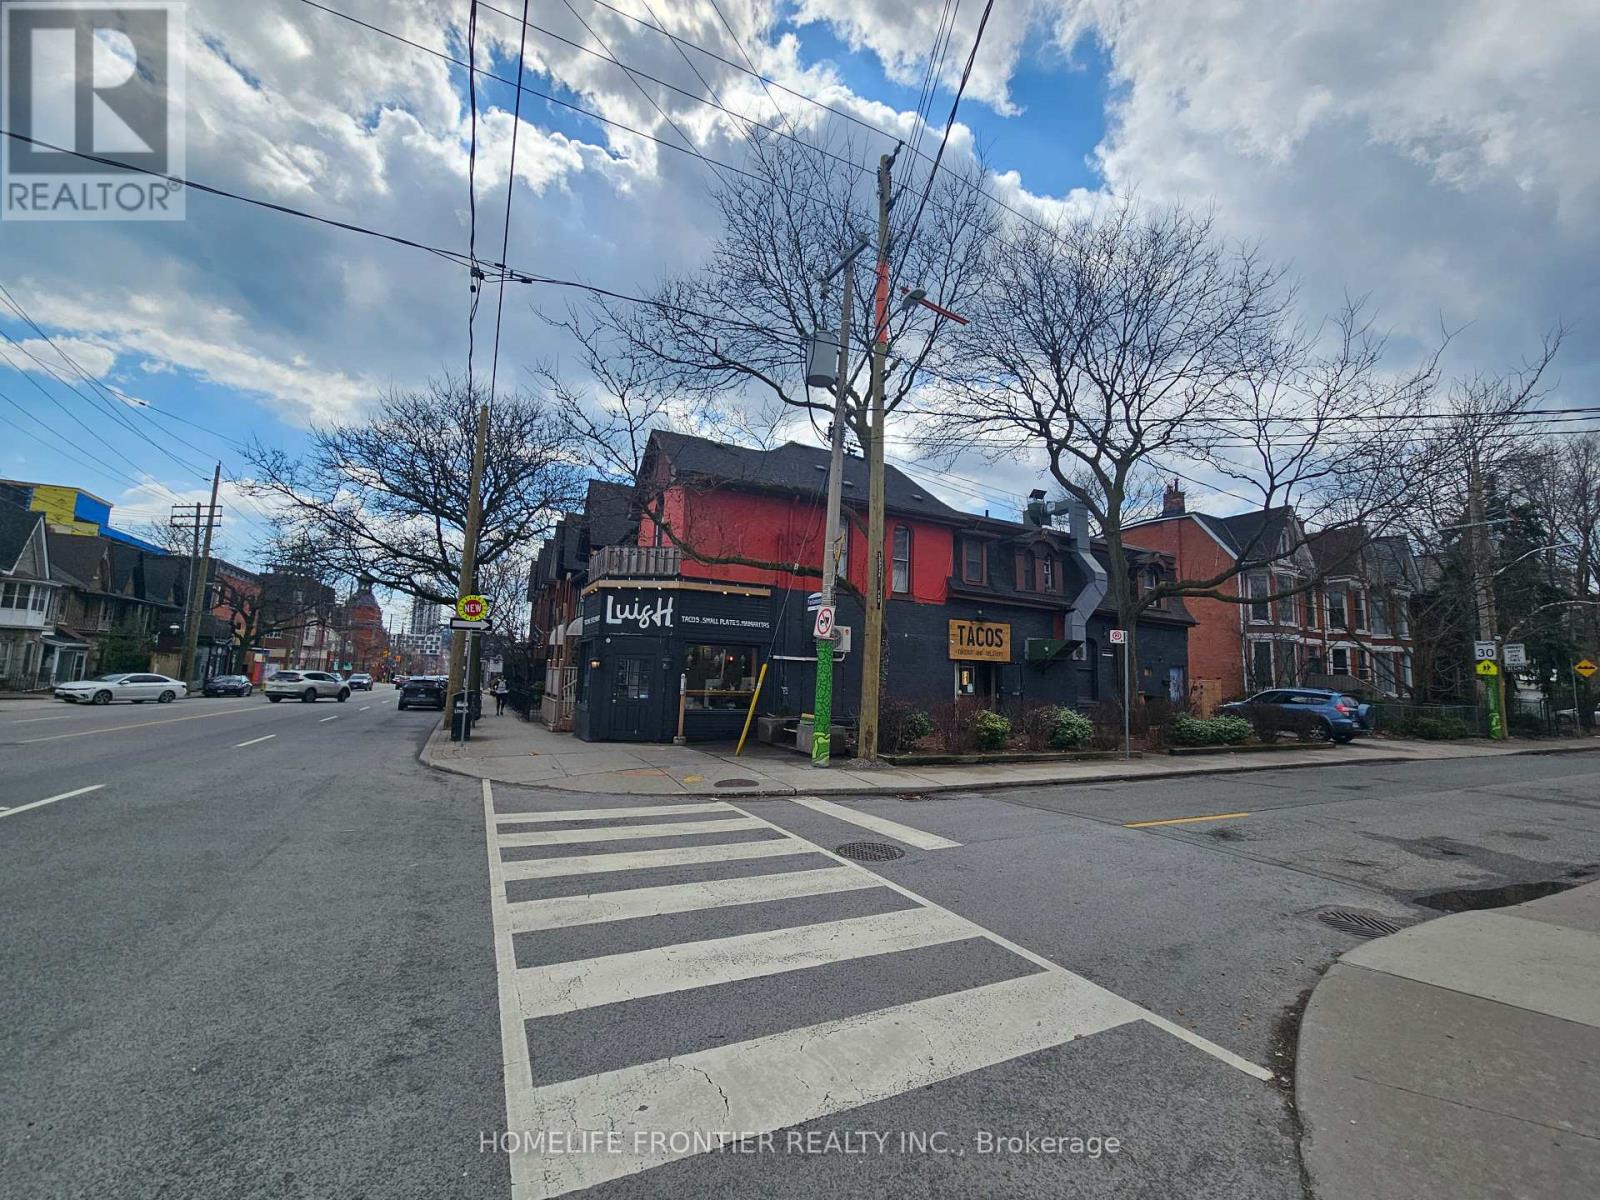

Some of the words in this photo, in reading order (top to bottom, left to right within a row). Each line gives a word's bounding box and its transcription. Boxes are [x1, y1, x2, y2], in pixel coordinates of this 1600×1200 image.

[464, 603, 482, 613] NEW
[957, 624, 1003, 648] TACOS
[1477, 648, 1494, 658] 30
